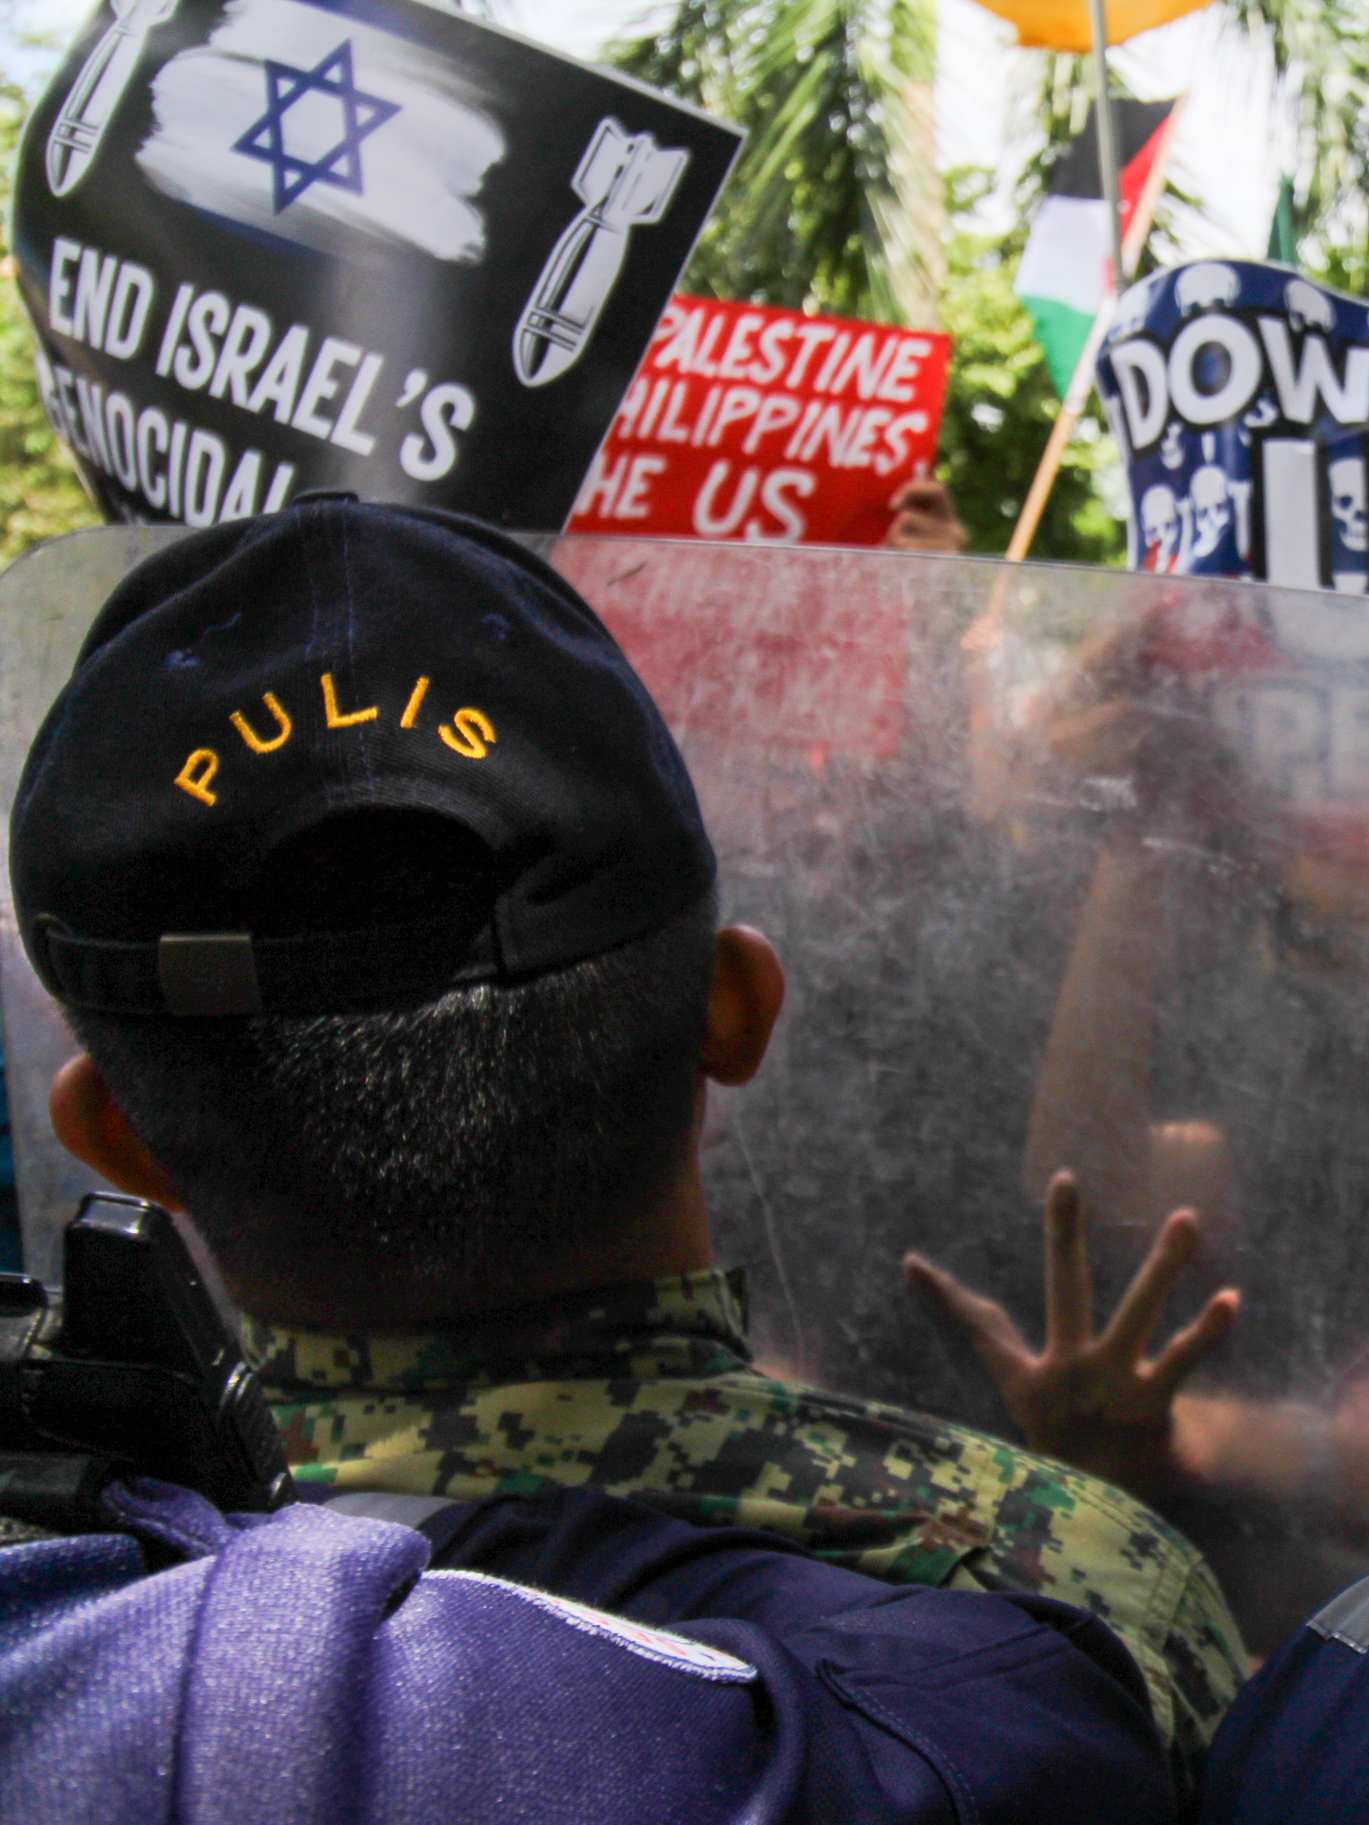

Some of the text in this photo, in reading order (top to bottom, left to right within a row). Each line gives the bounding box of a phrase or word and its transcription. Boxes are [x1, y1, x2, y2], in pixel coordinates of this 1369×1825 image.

[48, 236, 476, 482] END ISRAEL'S
[652, 304, 932, 403] PALESTINE
[614, 375, 929, 477] HILIPPINES
[573, 447, 818, 545] HE US
[174, 672, 497, 807] PULIS
